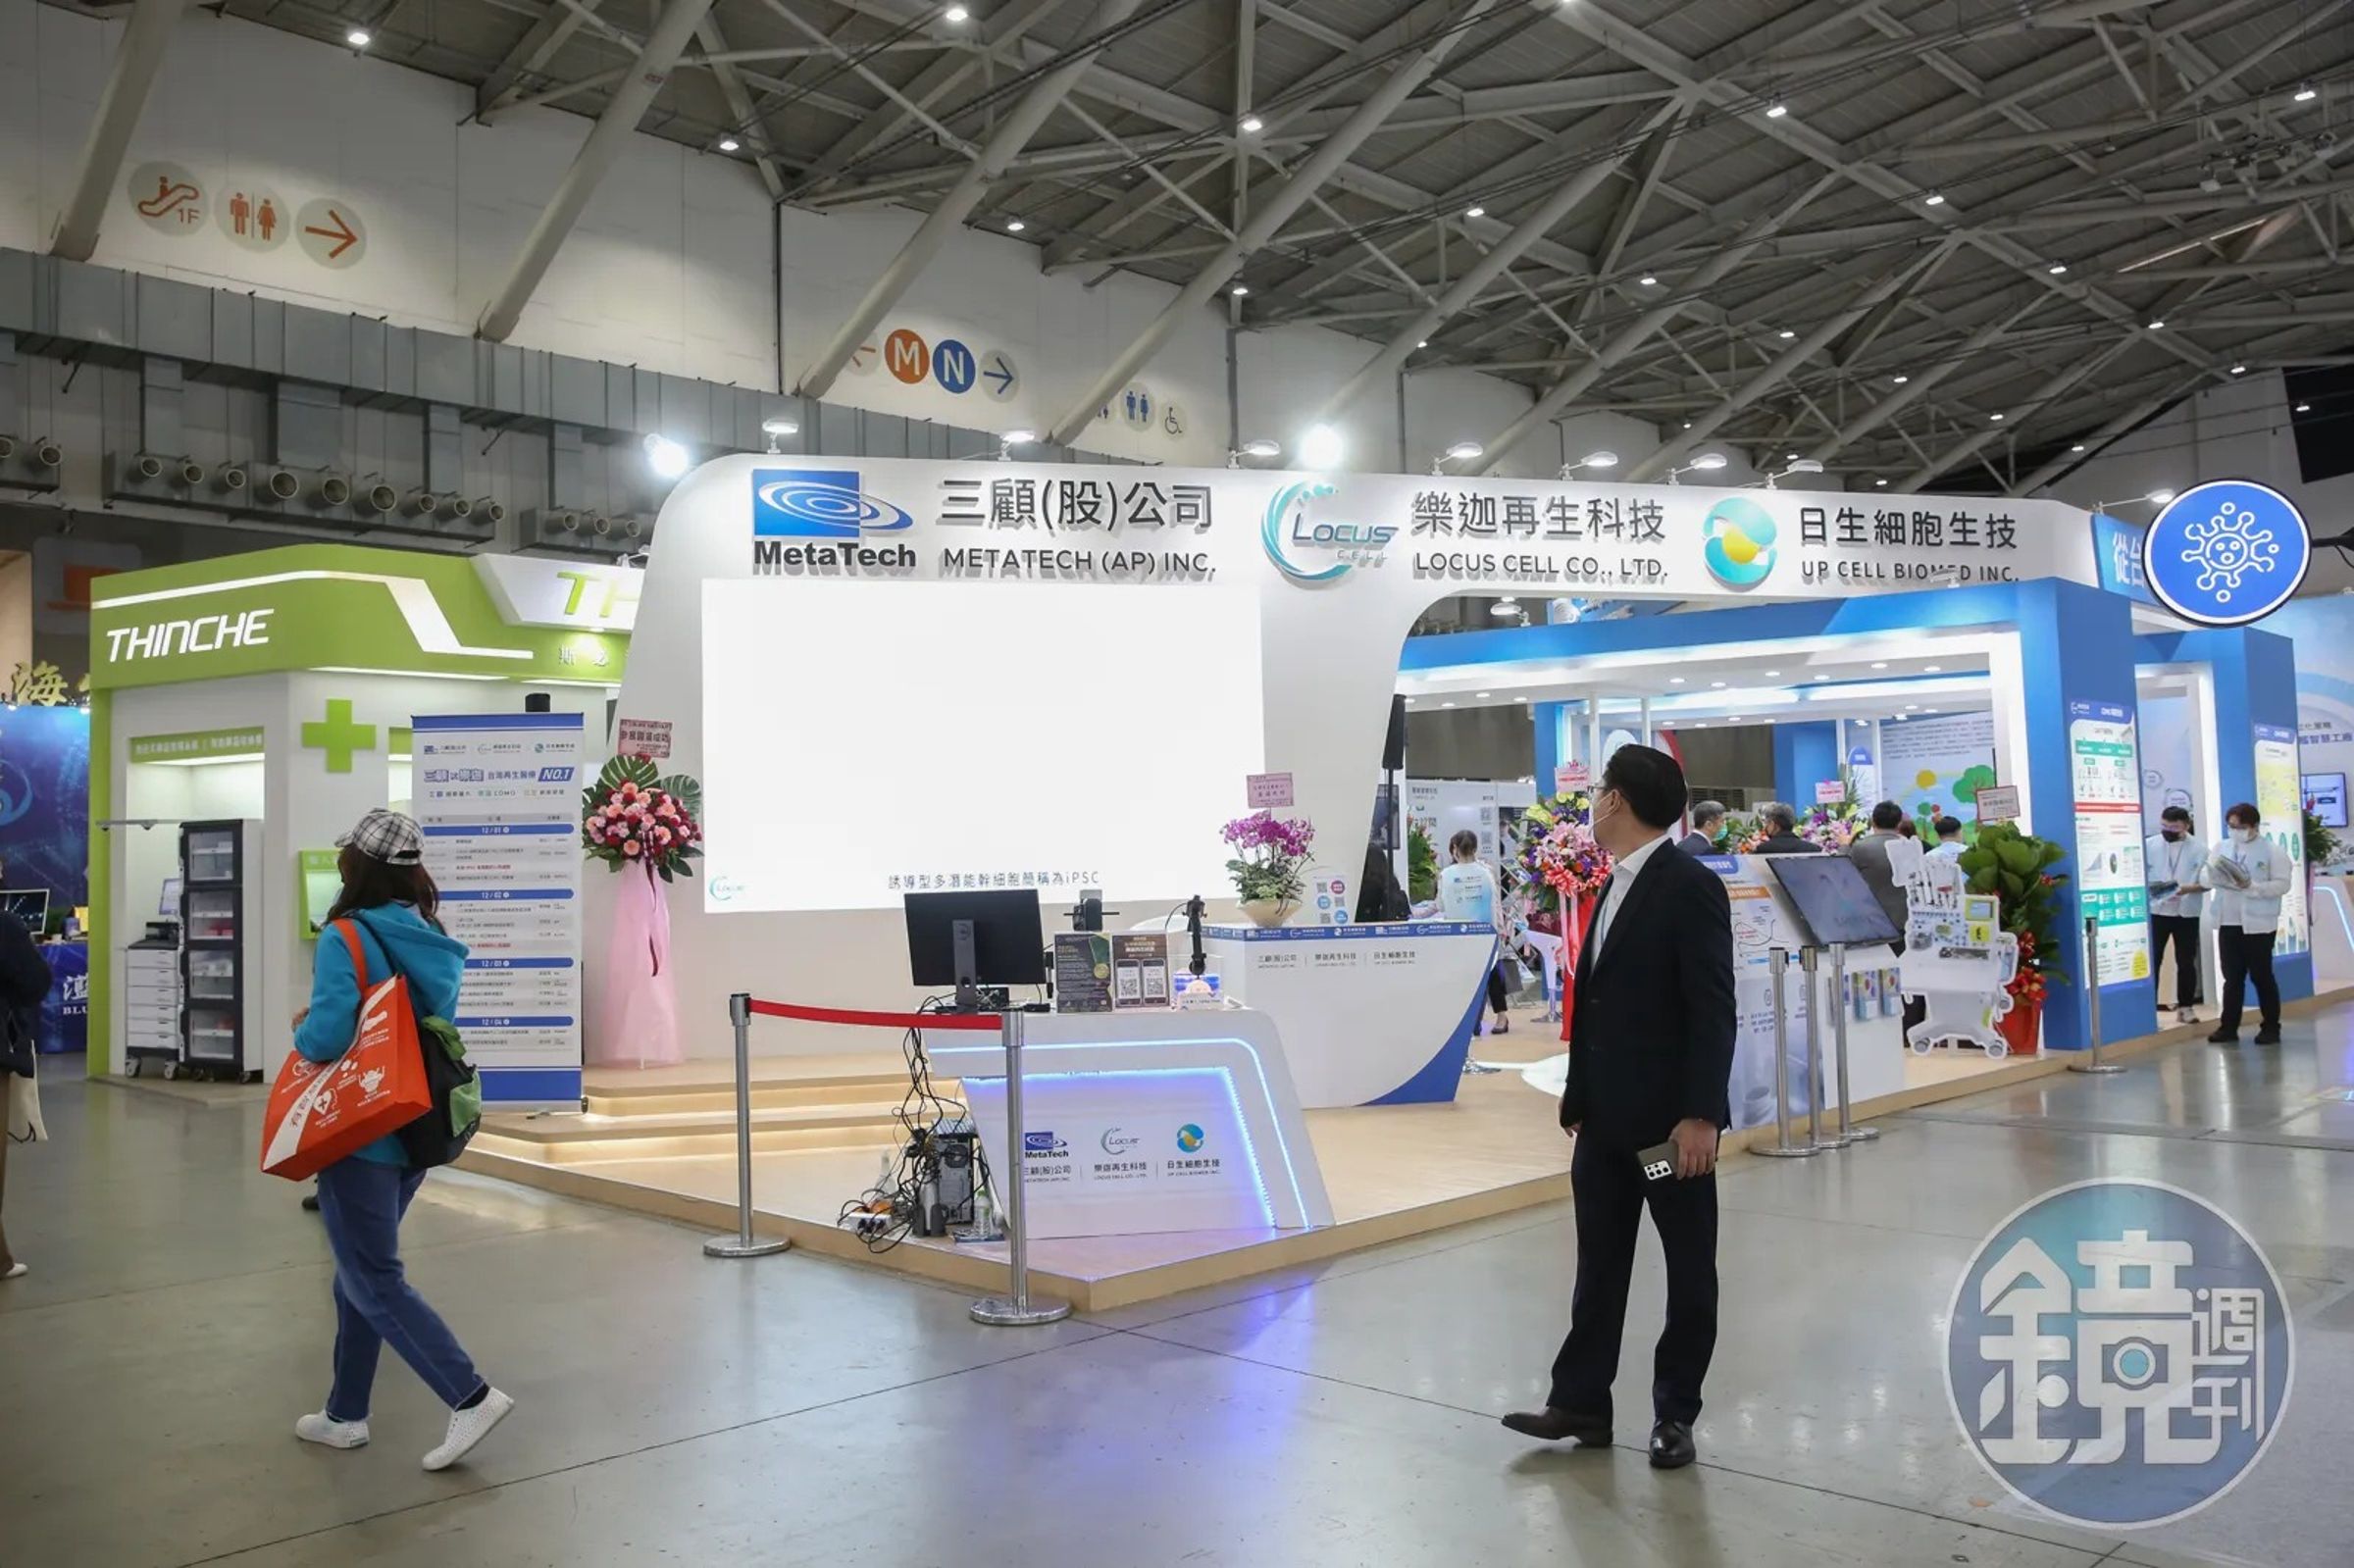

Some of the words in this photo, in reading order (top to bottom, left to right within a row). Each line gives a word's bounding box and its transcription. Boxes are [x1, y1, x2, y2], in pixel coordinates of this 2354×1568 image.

[178, 208, 200, 225] 1F
[894, 337, 924, 377] M
[943, 347, 966, 386] N
[942, 479, 1212, 531] 三顧(股)公司
[1414, 492, 1665, 540] 樂迦再生科技
[1800, 506, 2018, 549] 日生細胞生技
[753, 541, 916, 567] MetaTech
[945, 549, 1093, 572] METATECH
[1101, 549, 1156, 575] (AP)
[1164, 550, 1217, 574] INC.
[1415, 552, 1496, 573] LOCUS
[1503, 554, 1560, 575] CELL
[1565, 555, 1614, 578] CO.,
[1620, 557, 1668, 578] LTD.
[1802, 561, 1828, 577] UP
[1838, 561, 1885, 579] CELL
[1895, 563, 1971, 581] BIOD
[1979, 566, 2020, 582] INC.
[106, 608, 275, 663] THINCHE
[542, 768, 570, 781] NO.1
[1025, 1150, 1069, 1159] MetaTech
